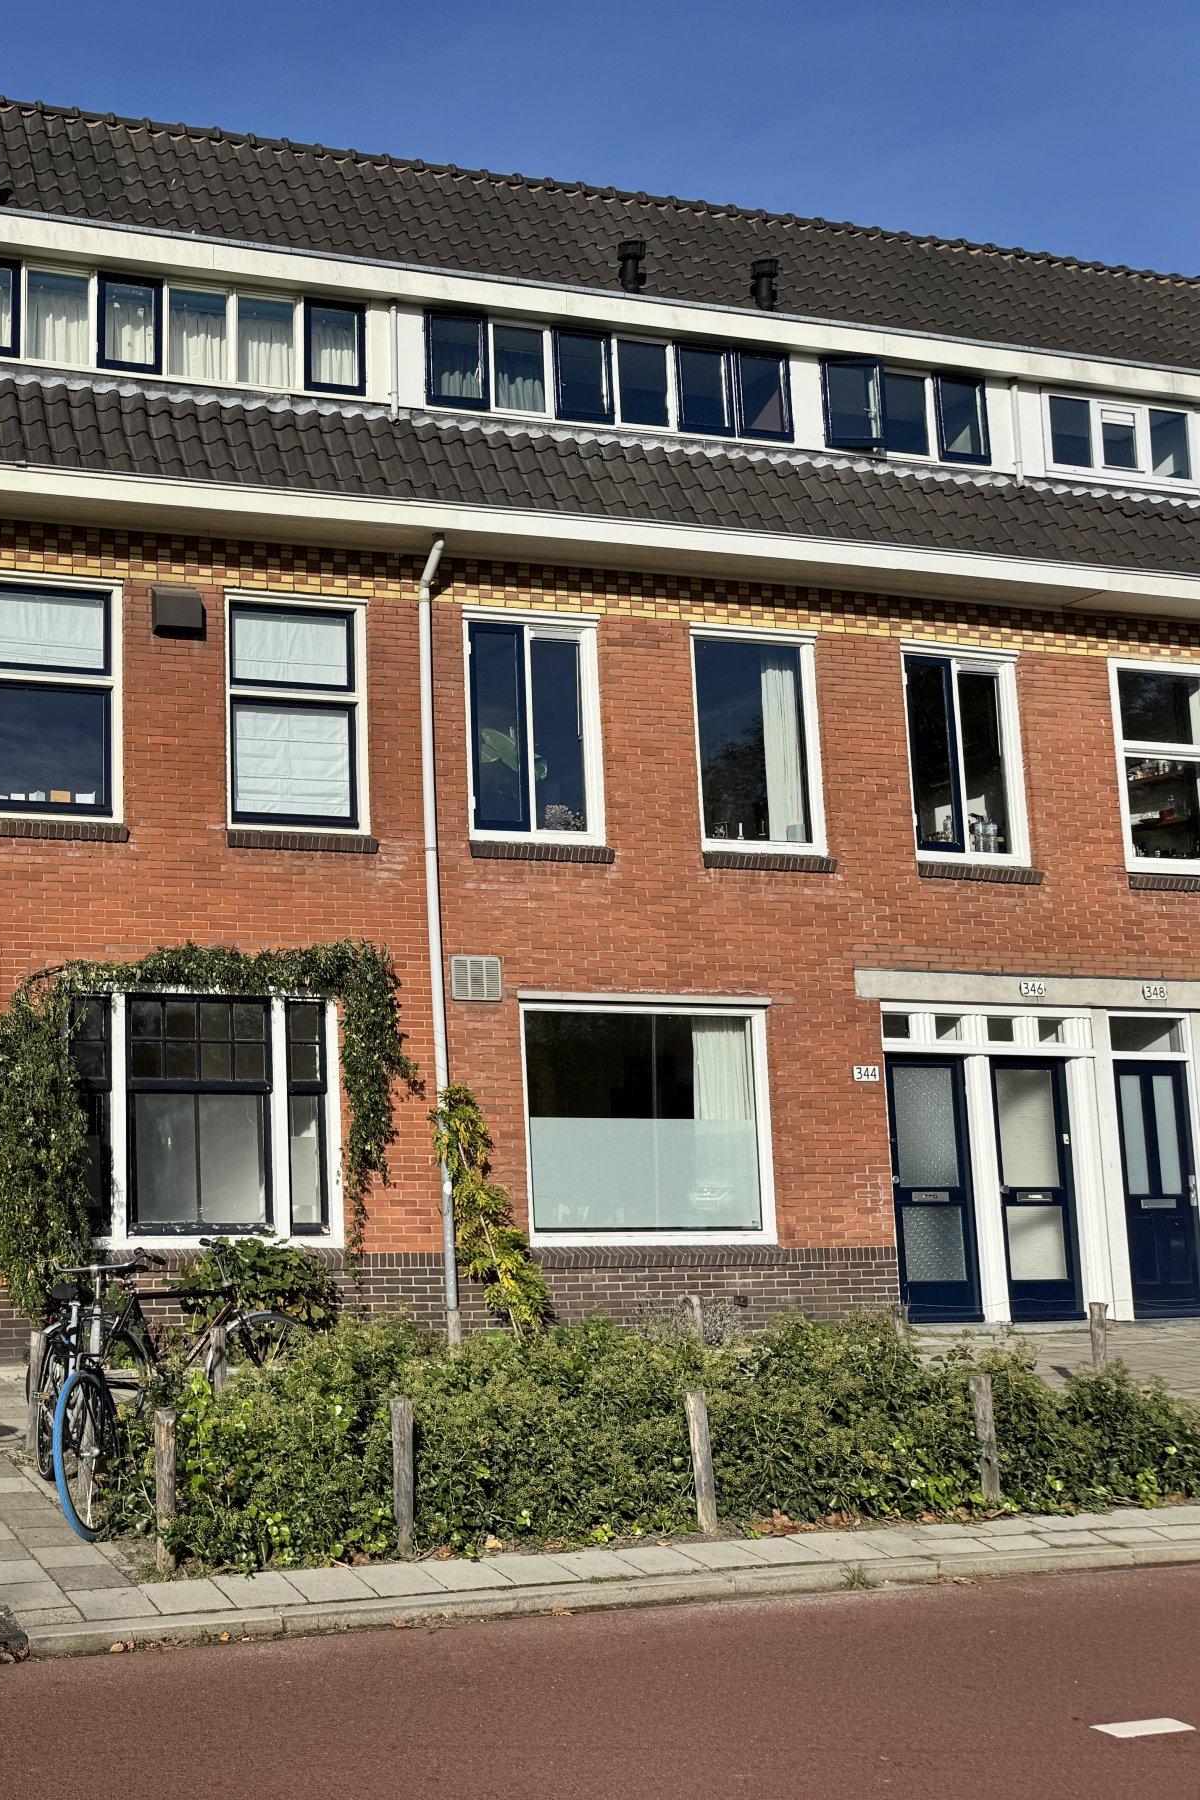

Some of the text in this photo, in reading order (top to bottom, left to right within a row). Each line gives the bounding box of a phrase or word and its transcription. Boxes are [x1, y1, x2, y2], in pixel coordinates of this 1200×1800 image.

[1023, 983, 1044, 995] 346
[1146, 986, 1166, 998] 348
[856, 1067, 877, 1080] 344
